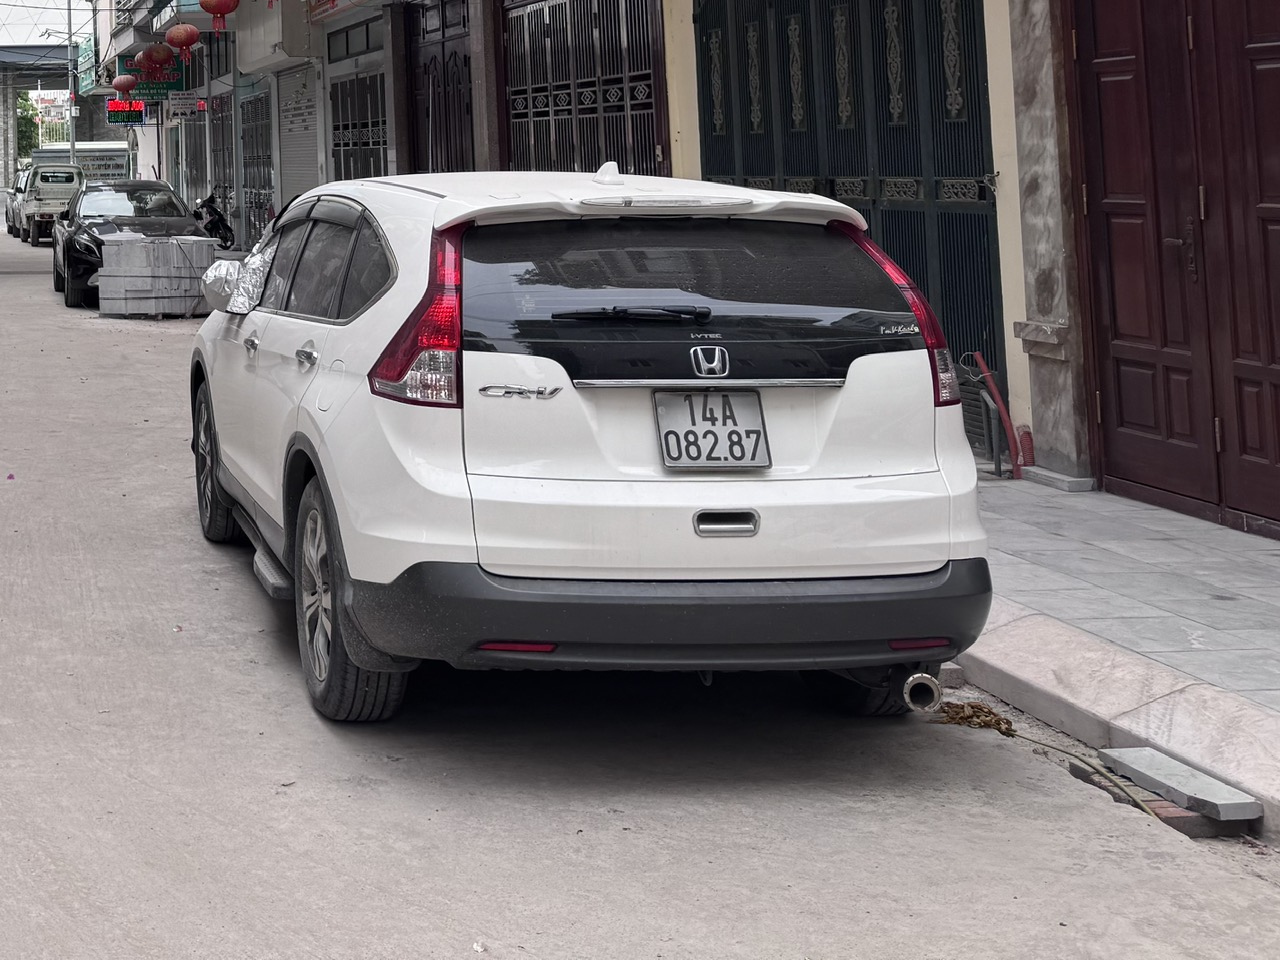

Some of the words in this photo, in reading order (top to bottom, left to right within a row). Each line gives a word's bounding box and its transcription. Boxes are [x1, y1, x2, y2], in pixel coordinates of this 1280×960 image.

[477, 382, 564, 400] CR-V
[684, 393, 738, 428] 14A
[664, 429, 762, 463] 082.87
